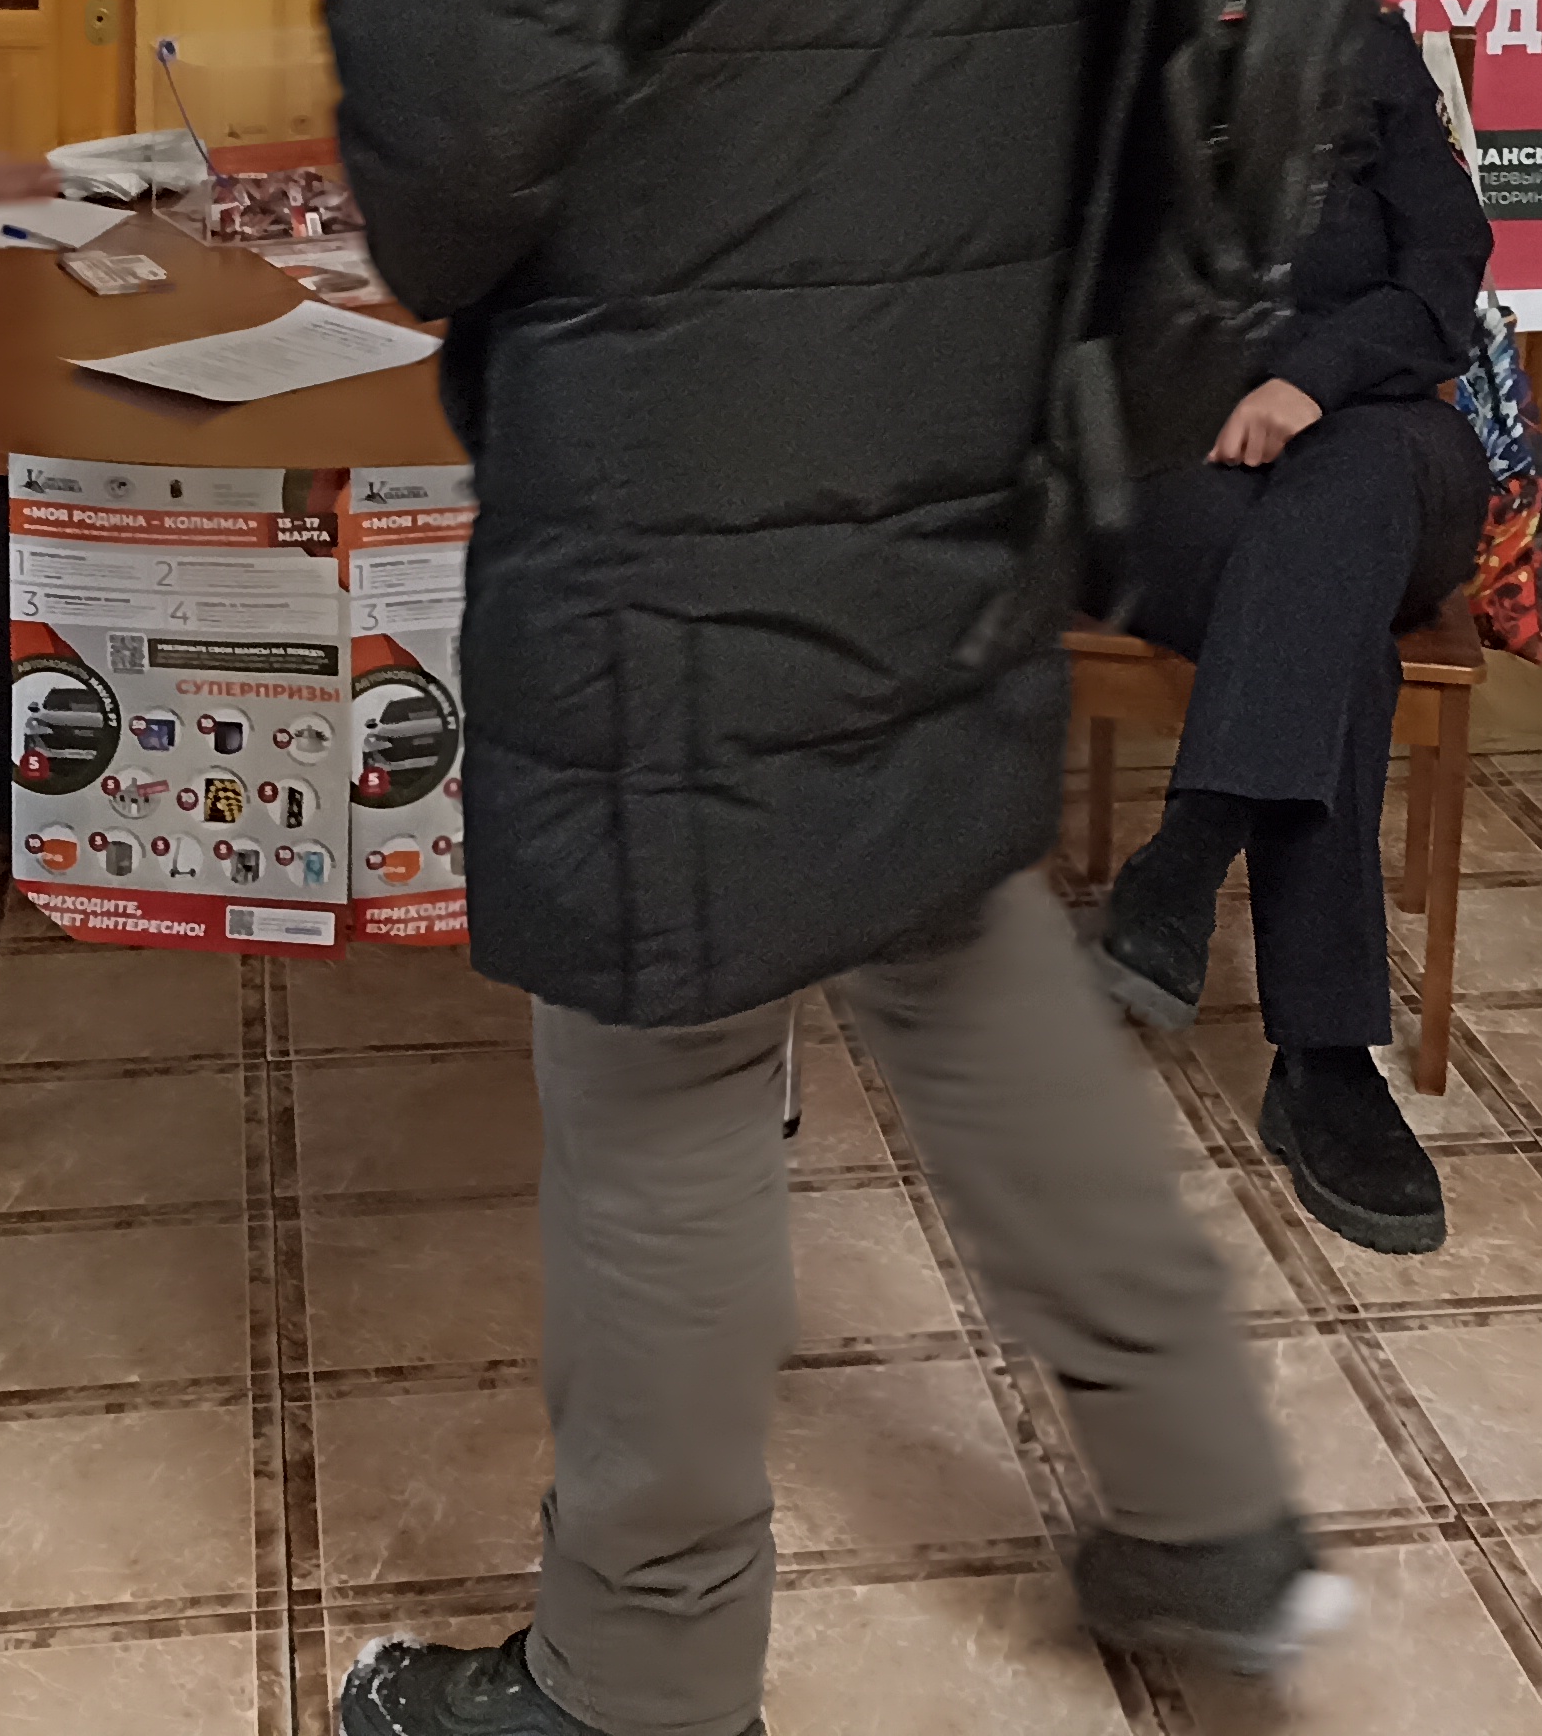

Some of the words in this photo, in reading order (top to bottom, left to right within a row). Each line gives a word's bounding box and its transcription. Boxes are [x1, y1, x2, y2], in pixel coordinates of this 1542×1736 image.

[73, 509, 147, 528] РОДИНА
[164, 516, 258, 531] КОЛЫМА»
[277, 530, 331, 543] МАРТА
[155, 560, 173, 587] 2
[21, 590, 40, 617] 3
[170, 600, 191, 626] 4
[360, 602, 379, 631] 3
[175, 678, 341, 704] СУПЕРПРИЗЫ
[28, 756, 40, 770] 5
[367, 772, 381, 786] 5
[87, 914, 206, 937] ИНТЕРЕСНО!
[365, 920, 429, 936] БУДЕТ
